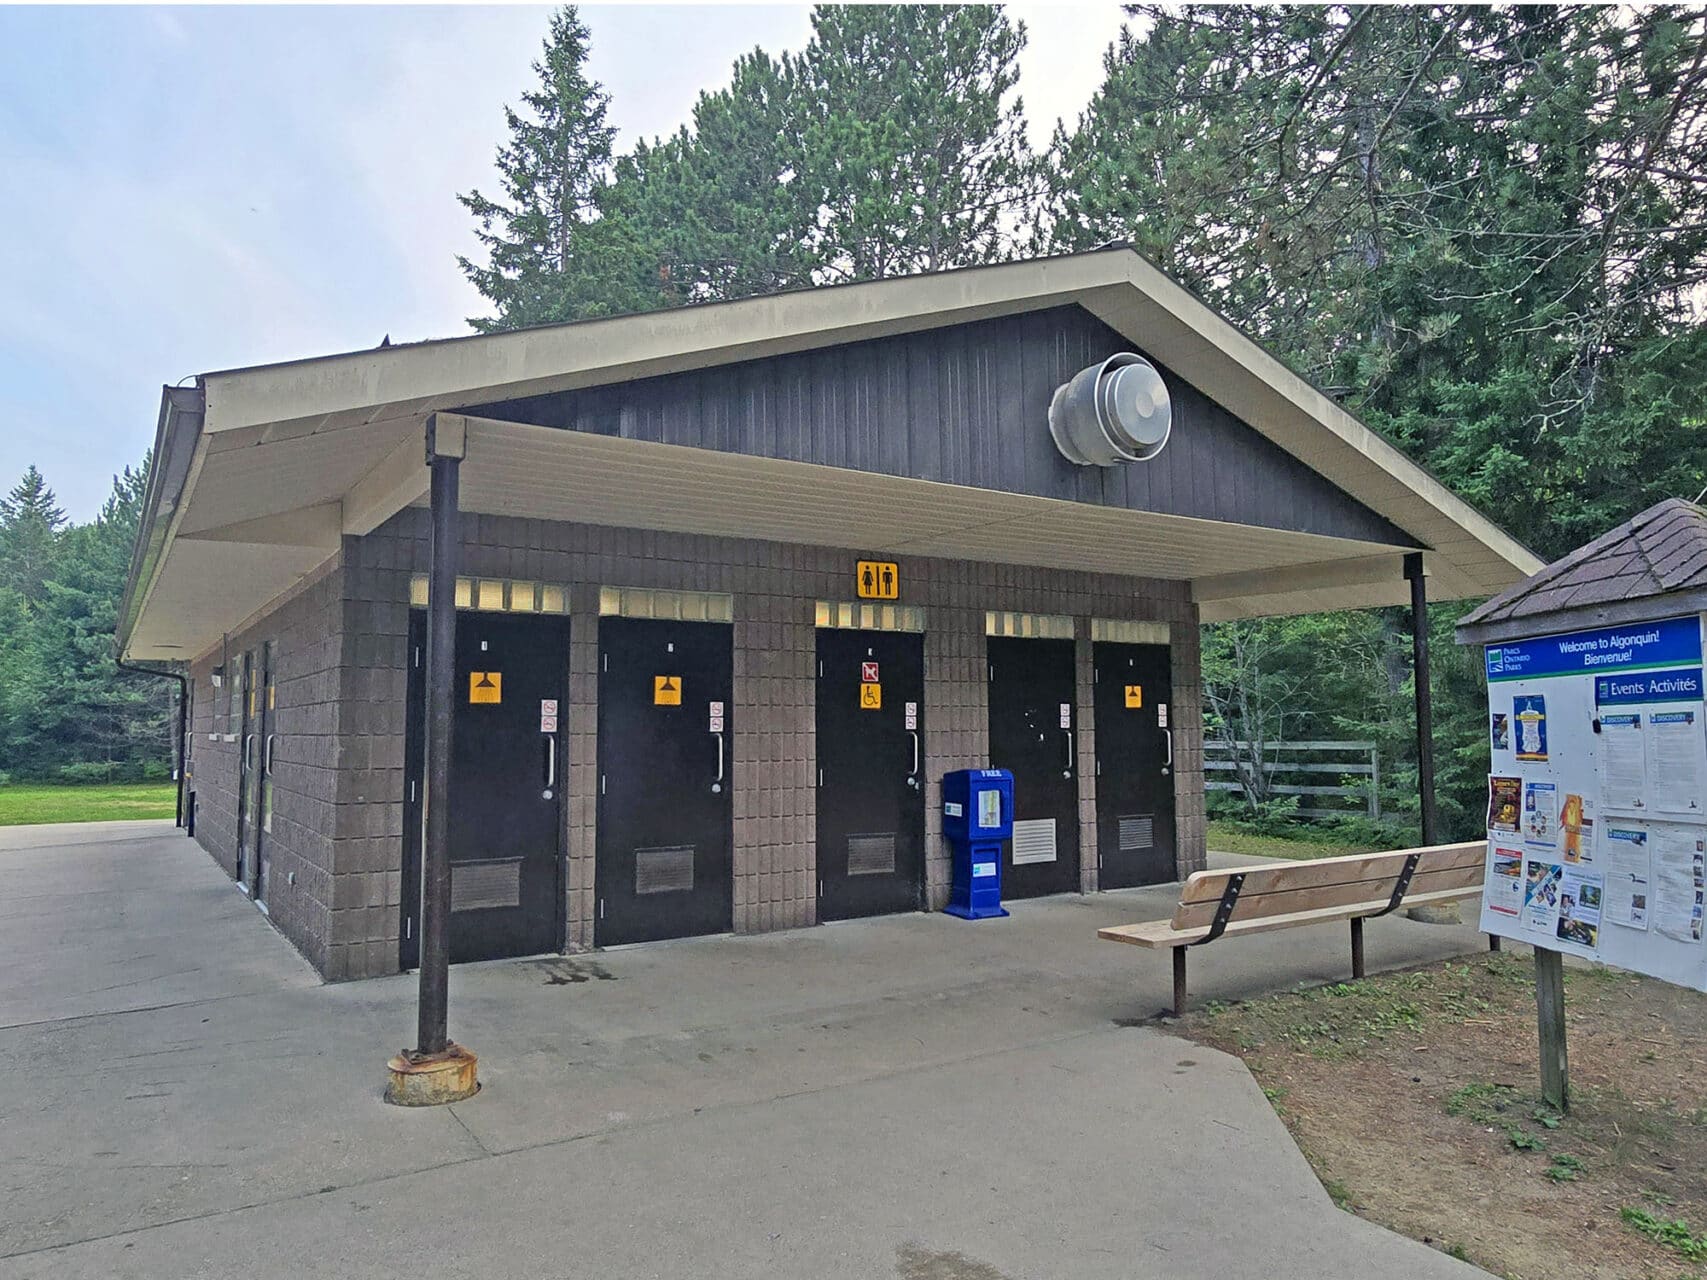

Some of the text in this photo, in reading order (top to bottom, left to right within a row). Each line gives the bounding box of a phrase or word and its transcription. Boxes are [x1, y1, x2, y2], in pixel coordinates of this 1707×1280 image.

[1559, 630, 1660, 654] Welcome to Algonquin!
[1584, 649, 1633, 665] Bienvenue!
[1611, 677, 1697, 695] Events Activités
